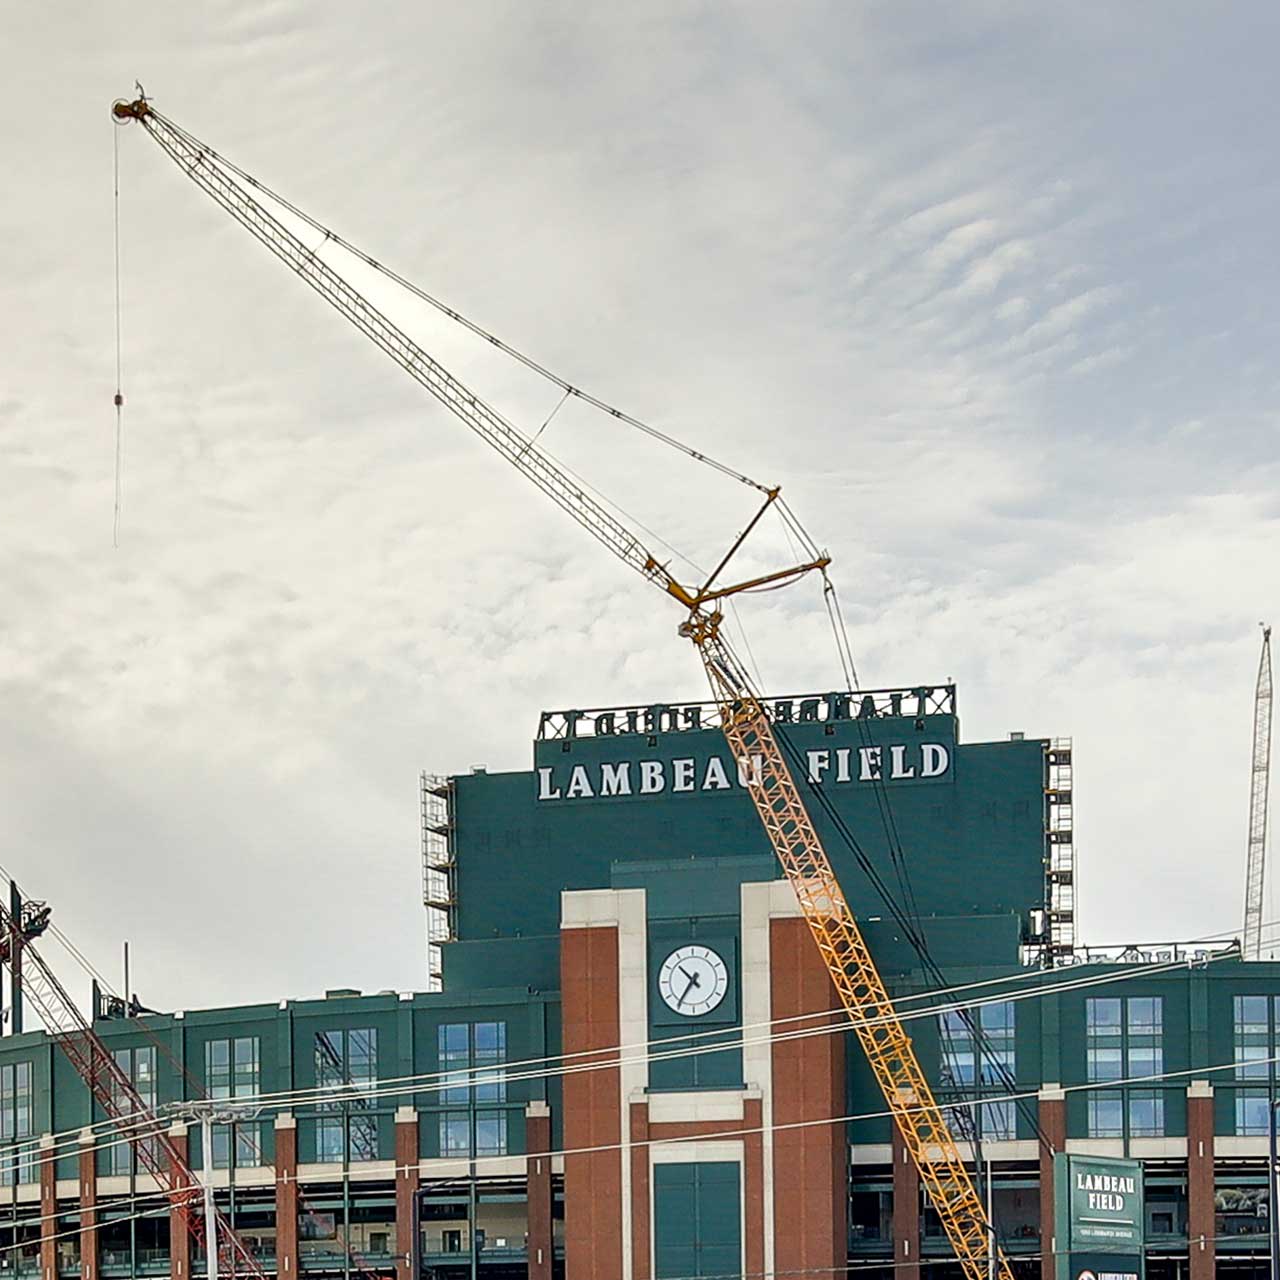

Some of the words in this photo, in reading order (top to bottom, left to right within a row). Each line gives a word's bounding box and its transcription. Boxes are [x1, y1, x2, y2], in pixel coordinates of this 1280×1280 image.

[537, 754, 763, 801] LAMBEAU
[806, 743, 950, 785] FIELD
[1077, 1172, 1135, 1194] LAMBEAU
[1088, 1193, 1124, 1211] FIELD
